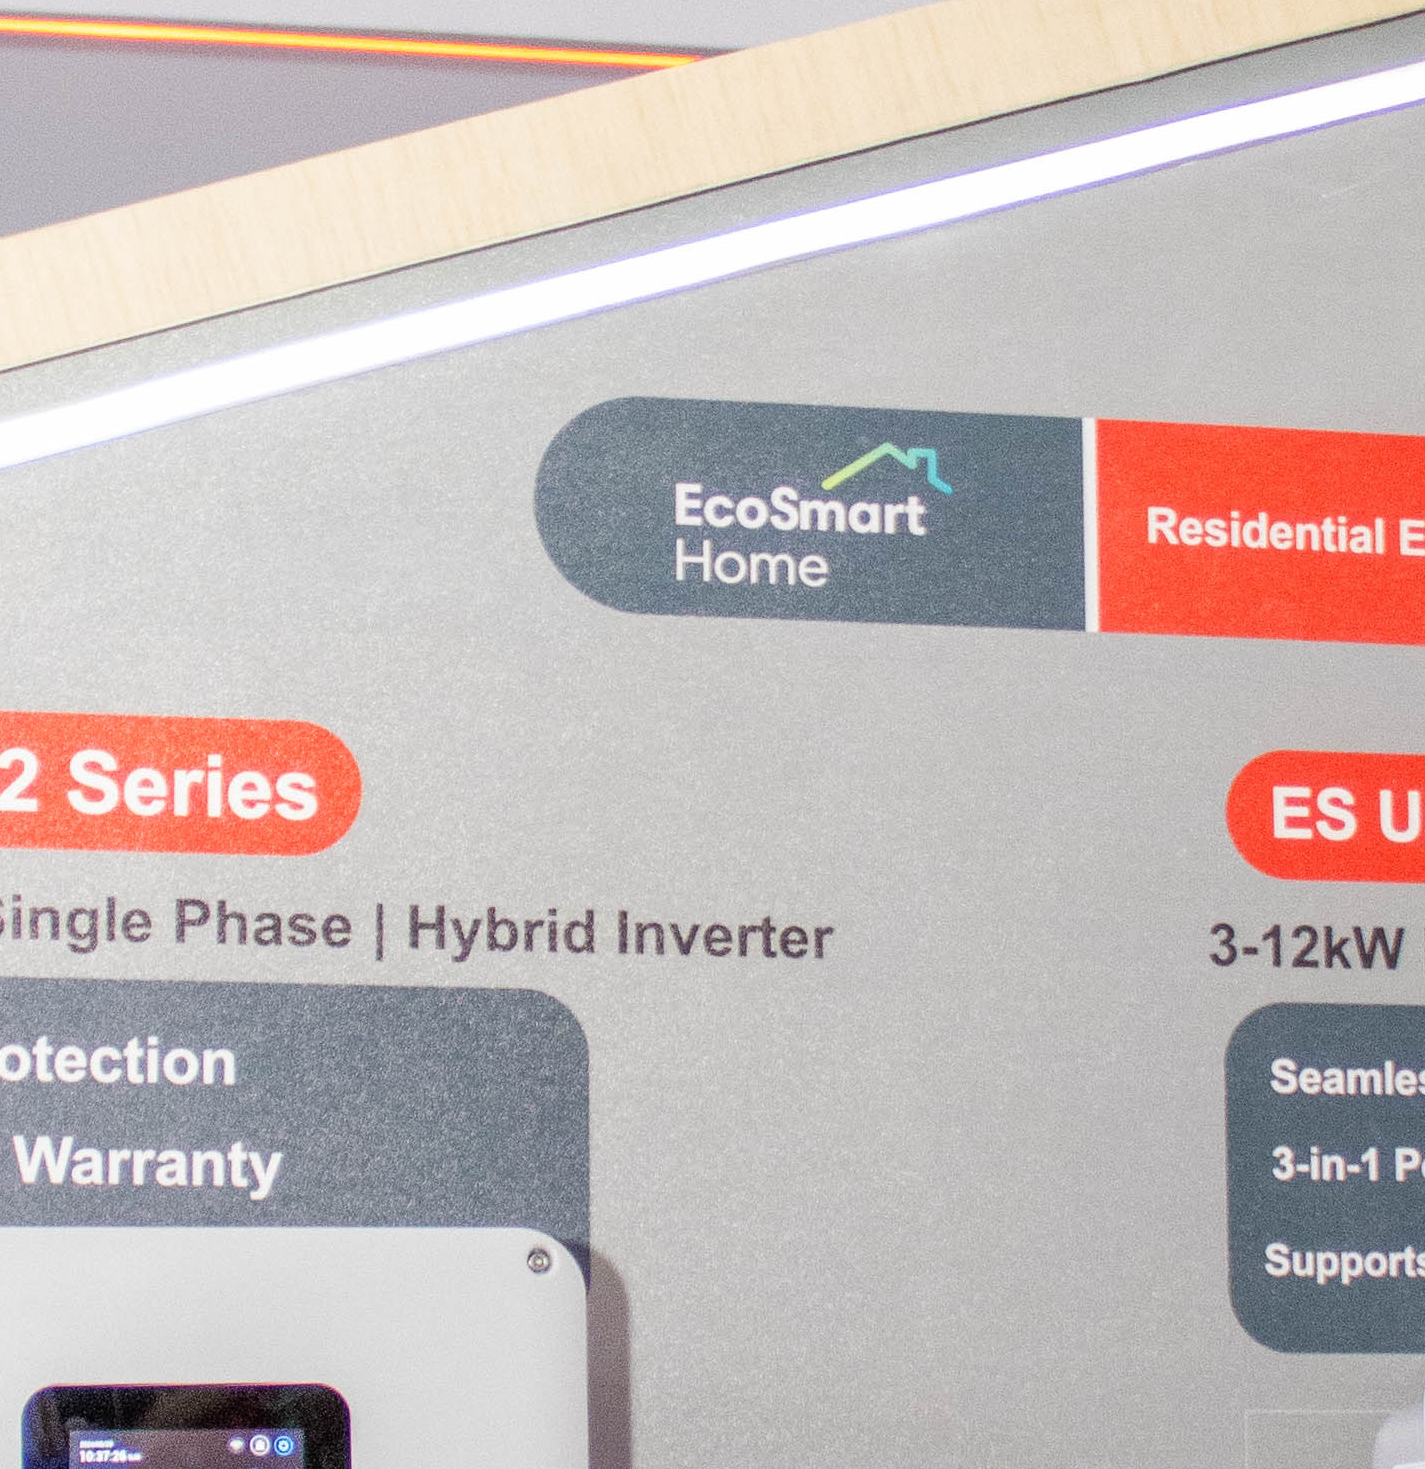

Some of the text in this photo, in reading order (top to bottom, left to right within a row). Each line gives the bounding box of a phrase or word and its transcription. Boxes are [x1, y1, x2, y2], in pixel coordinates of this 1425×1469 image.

[674, 482, 928, 536] EcoSmart
[1146, 505, 1385, 556] Residential
[674, 538, 829, 588] Home
[67, 748, 318, 821] Series
[1272, 785, 1357, 841] ES
[175, 898, 353, 948] Phase
[408, 904, 595, 964] Hybrid
[617, 909, 835, 960] Inverter
[1209, 922, 1405, 971] 3-12kW
[12, 1135, 282, 1202] Warranty
[1271, 1146, 1381, 1183] 3-in-1
